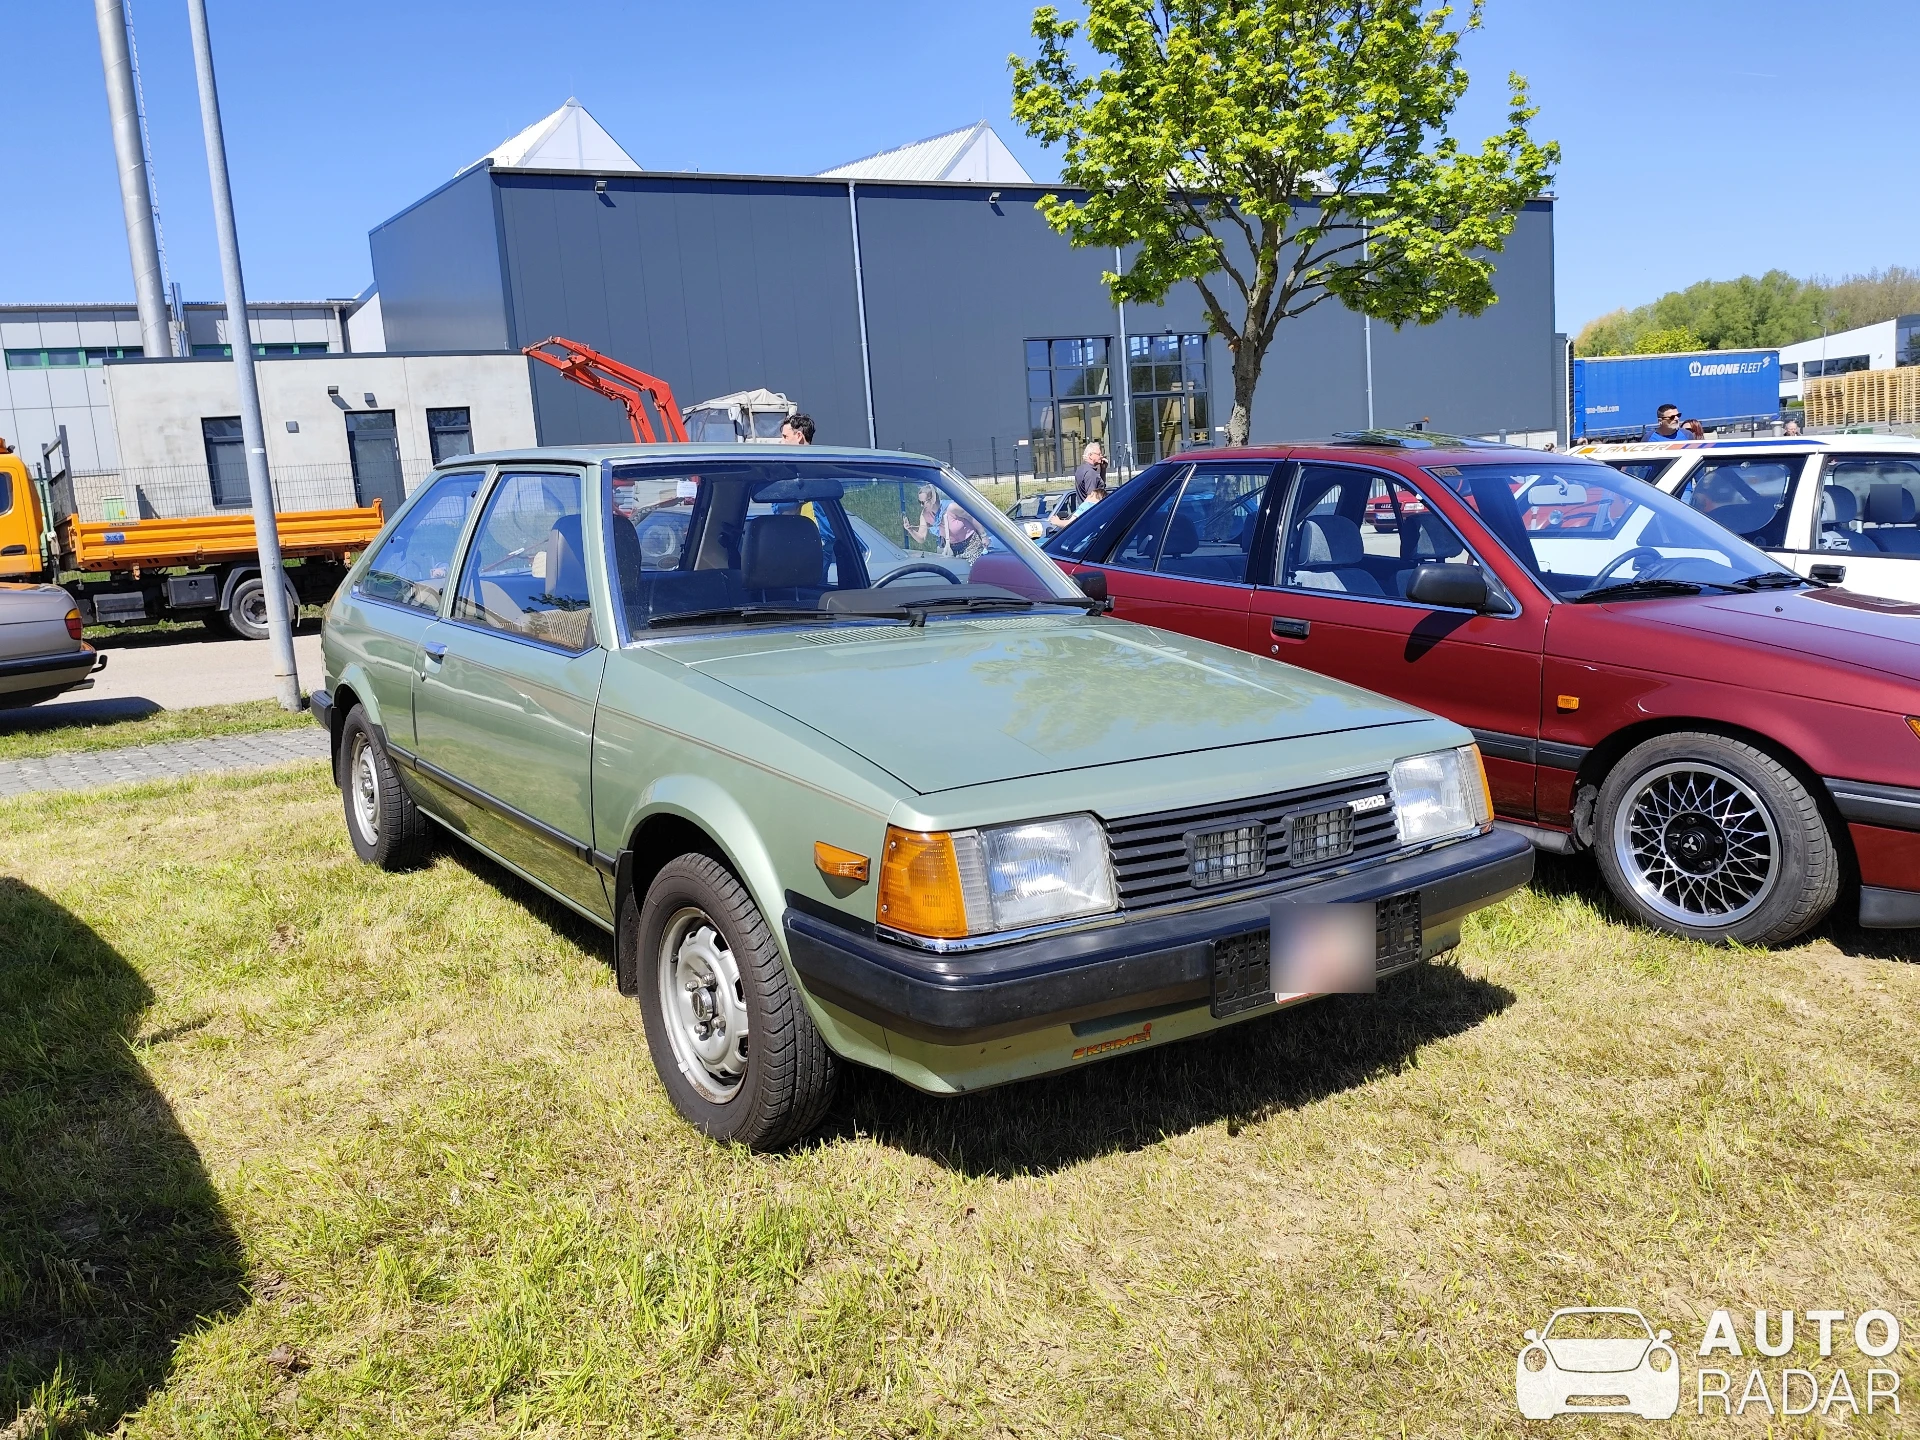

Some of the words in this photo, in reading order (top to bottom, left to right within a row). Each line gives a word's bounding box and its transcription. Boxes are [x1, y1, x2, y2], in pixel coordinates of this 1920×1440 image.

[1701, 363, 1740, 376] KRONE
[1740, 362, 1762, 374] FLEET
[1594, 443, 1670, 454] LANCER
